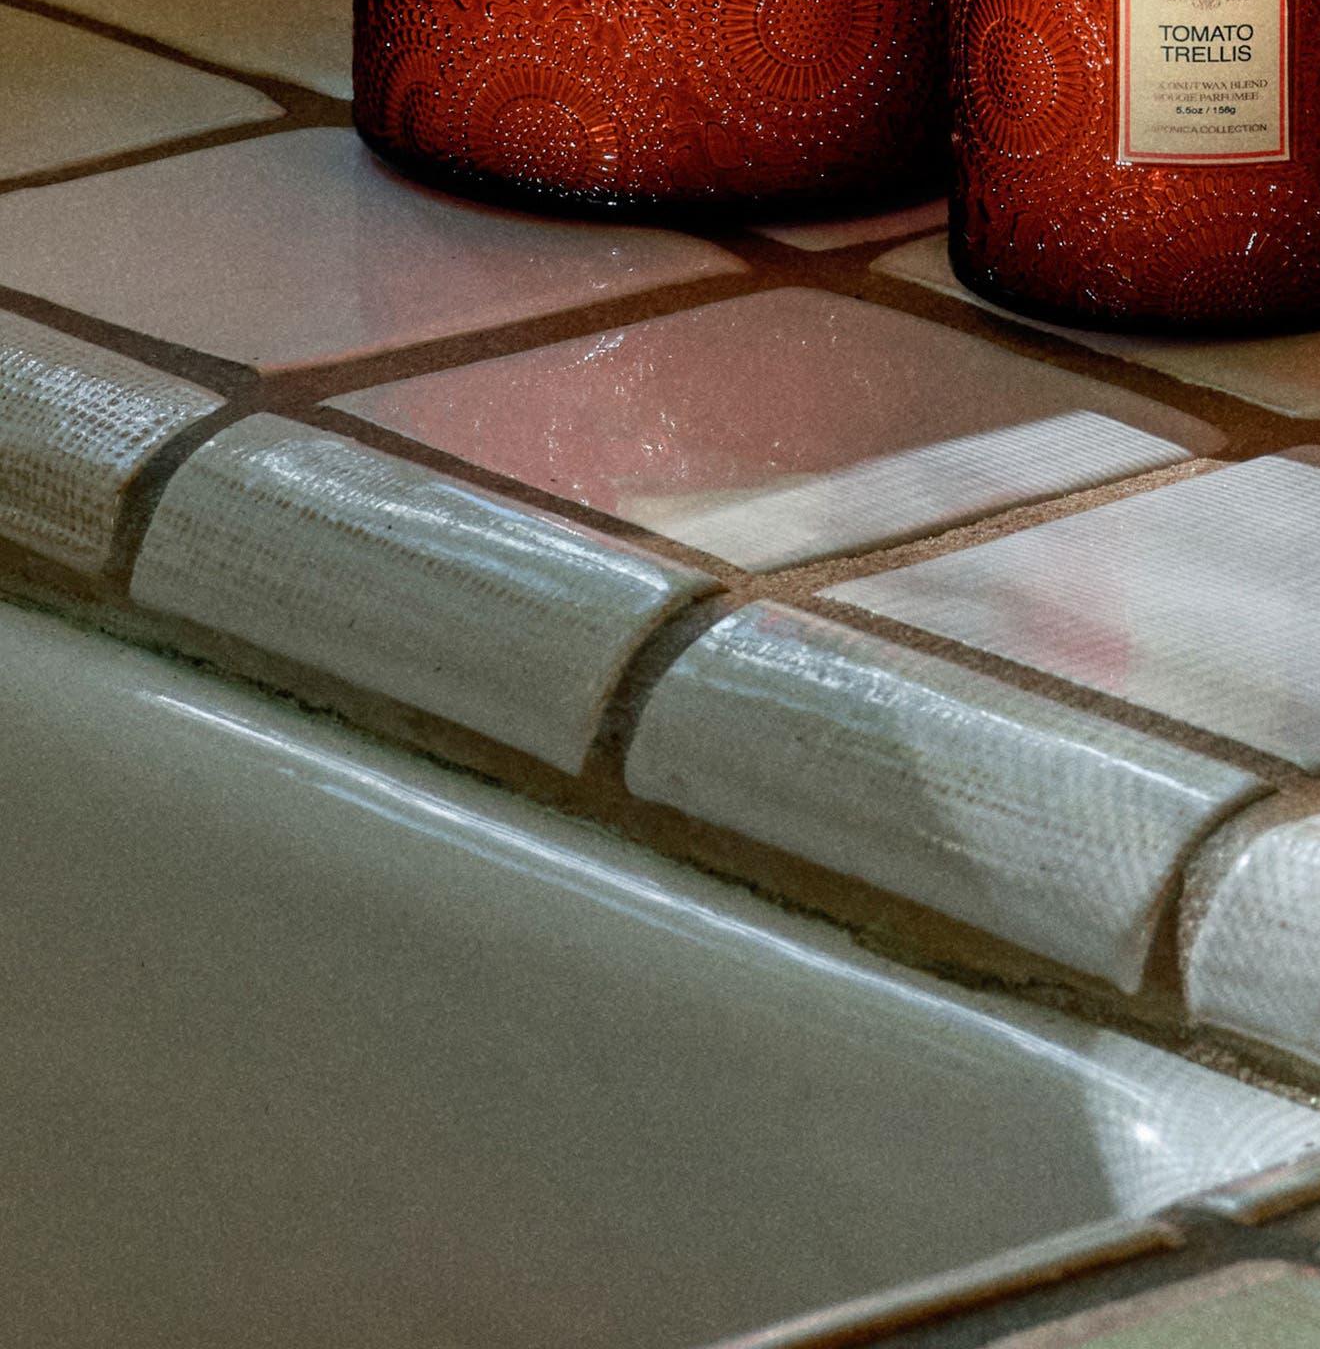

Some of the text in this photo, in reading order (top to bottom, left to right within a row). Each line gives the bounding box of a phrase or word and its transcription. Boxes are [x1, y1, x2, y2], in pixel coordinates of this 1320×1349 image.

[1159, 24, 1254, 42] TOMATO
[1161, 45, 1252, 63] TRELLIS
[1230, 79, 1268, 89] BLEND
[1176, 106, 1203, 114] 5.5oz
[1200, 124, 1267, 134] COLLECTION
